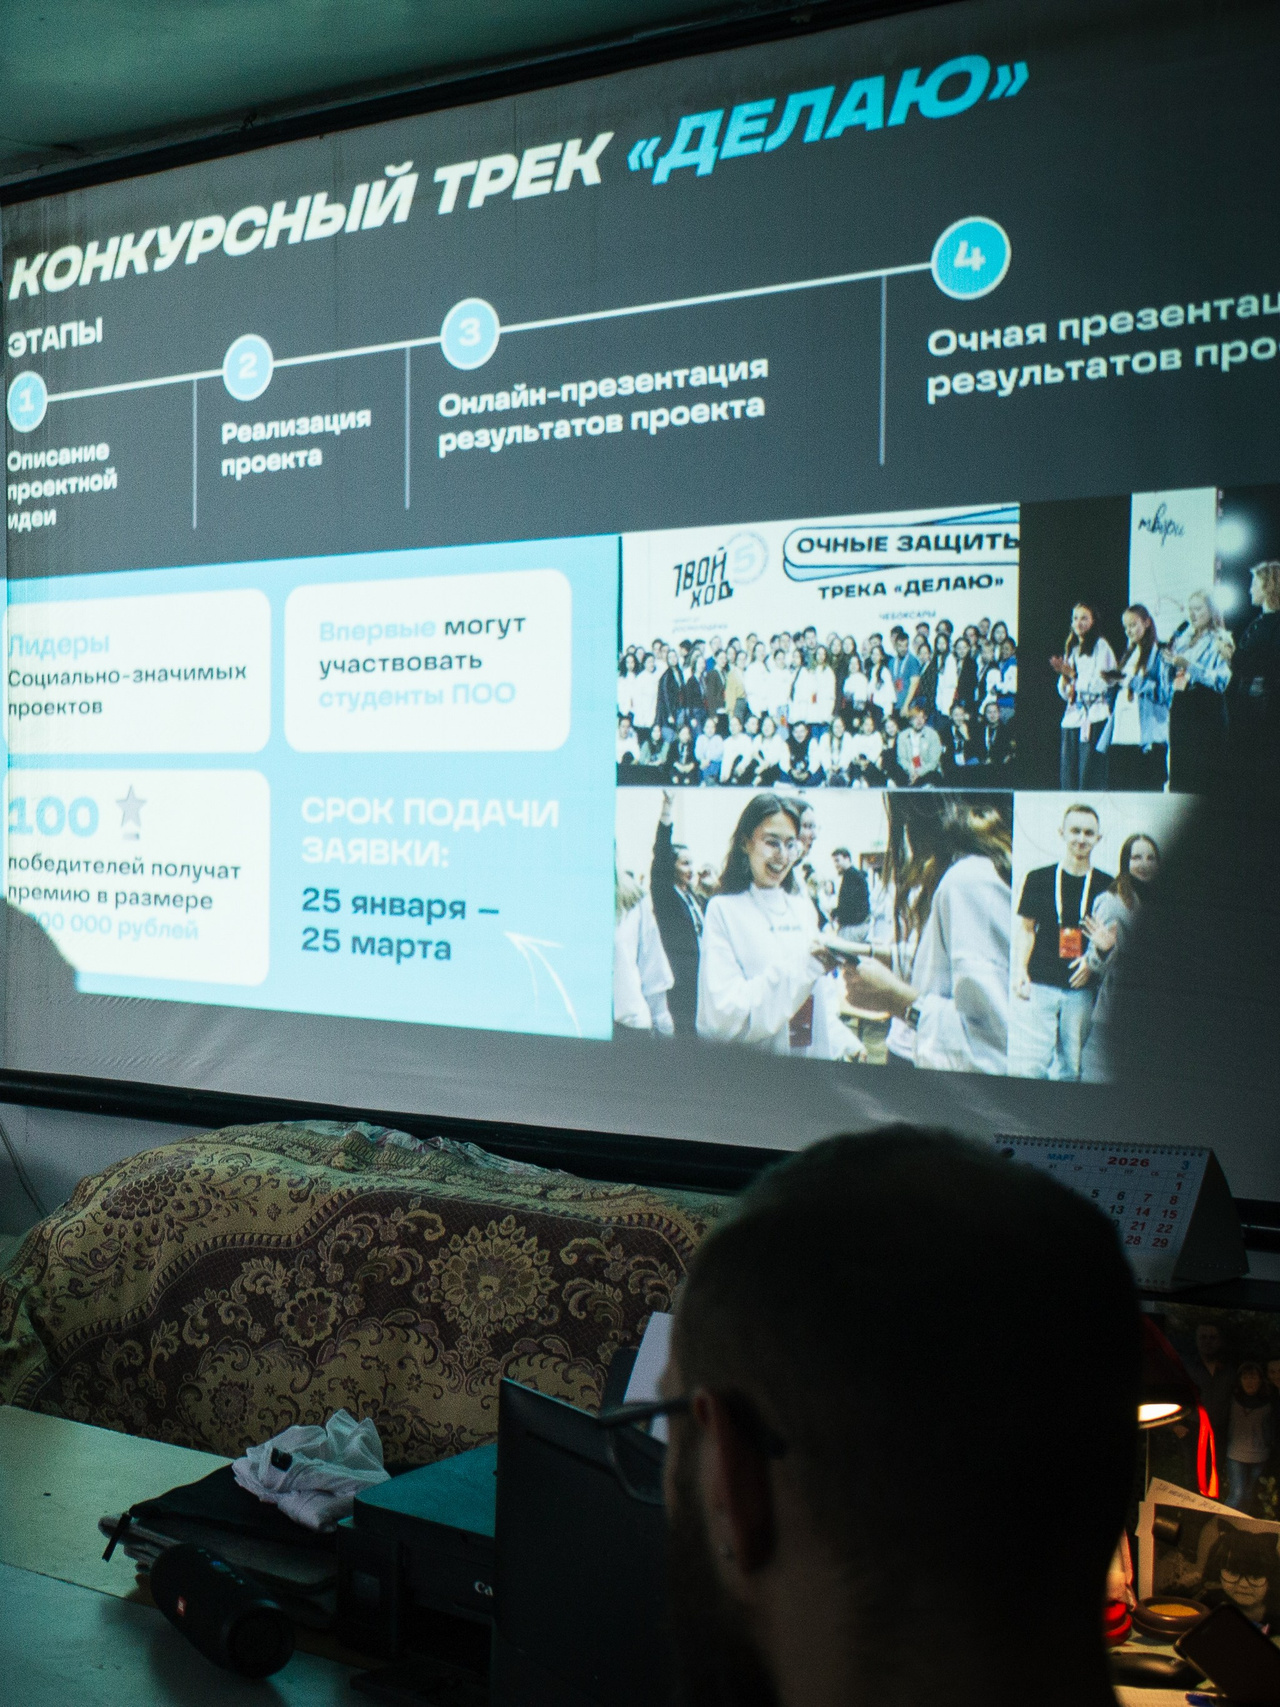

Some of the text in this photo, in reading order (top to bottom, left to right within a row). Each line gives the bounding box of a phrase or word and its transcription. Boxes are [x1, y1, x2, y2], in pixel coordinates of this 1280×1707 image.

[8, 53, 1030, 301] КОНКУРСНЫЙ ТРЕК «ДЕЛАЮ»
[953, 240, 986, 272] 4
[8, 317, 103, 358] ЭТАПЫ
[458, 317, 481, 346] 3
[927, 322, 1047, 357] Очная
[238, 352, 257, 379] 2
[927, 336, 1280, 405] результатов про
[18, 388, 34, 413] 1
[438, 358, 768, 417] Онлайн-презентация
[221, 409, 372, 445] Реализация
[438, 396, 765, 459] результатов проекта
[7, 442, 110, 471] Описание
[221, 447, 323, 481] проекта
[8, 467, 118, 505] проектной
[8, 509, 56, 533] идеи
[796, 536, 888, 554] ОЧНЫЕ
[818, 574, 1003, 600] ТРЕКА «ДЕЛАЮ»
[319, 617, 526, 645] Впервые могут
[8, 634, 110, 660] Лидеры
[8, 665, 247, 689] Социально-значимых
[319, 654, 483, 680] участвовать
[8, 700, 104, 721] проектов
[318, 682, 516, 712] студенты ПОО
[8, 795, 99, 838] 100
[301, 796, 559, 832] СРОК ПОДАЧИ
[301, 836, 449, 868] ЗАЯВКИ:
[8, 853, 241, 883] победителей получат
[8, 885, 213, 913] премию в размере
[301, 887, 341, 913] 25
[351, 895, 466, 925] января
[70, 914, 112, 935] 000
[118, 917, 199, 941] рублей
[301, 926, 452, 965] 25 марта
[1107, 1156, 1149, 1168] 2026
[1181, 1160, 1190, 1171] 3
[1117, 1191, 1125, 1200] 6
[1144, 1193, 1152, 1202] 7
[1169, 1195, 1177, 1205] 8
[1175, 1181, 1182, 1191] 1
[1109, 1204, 1177, 1219] 13 14 15
[1125, 1235, 1168, 1248] 28 29
[1130, 1221, 1146, 1231] 21
[1156, 1223, 1172, 1234] 22
